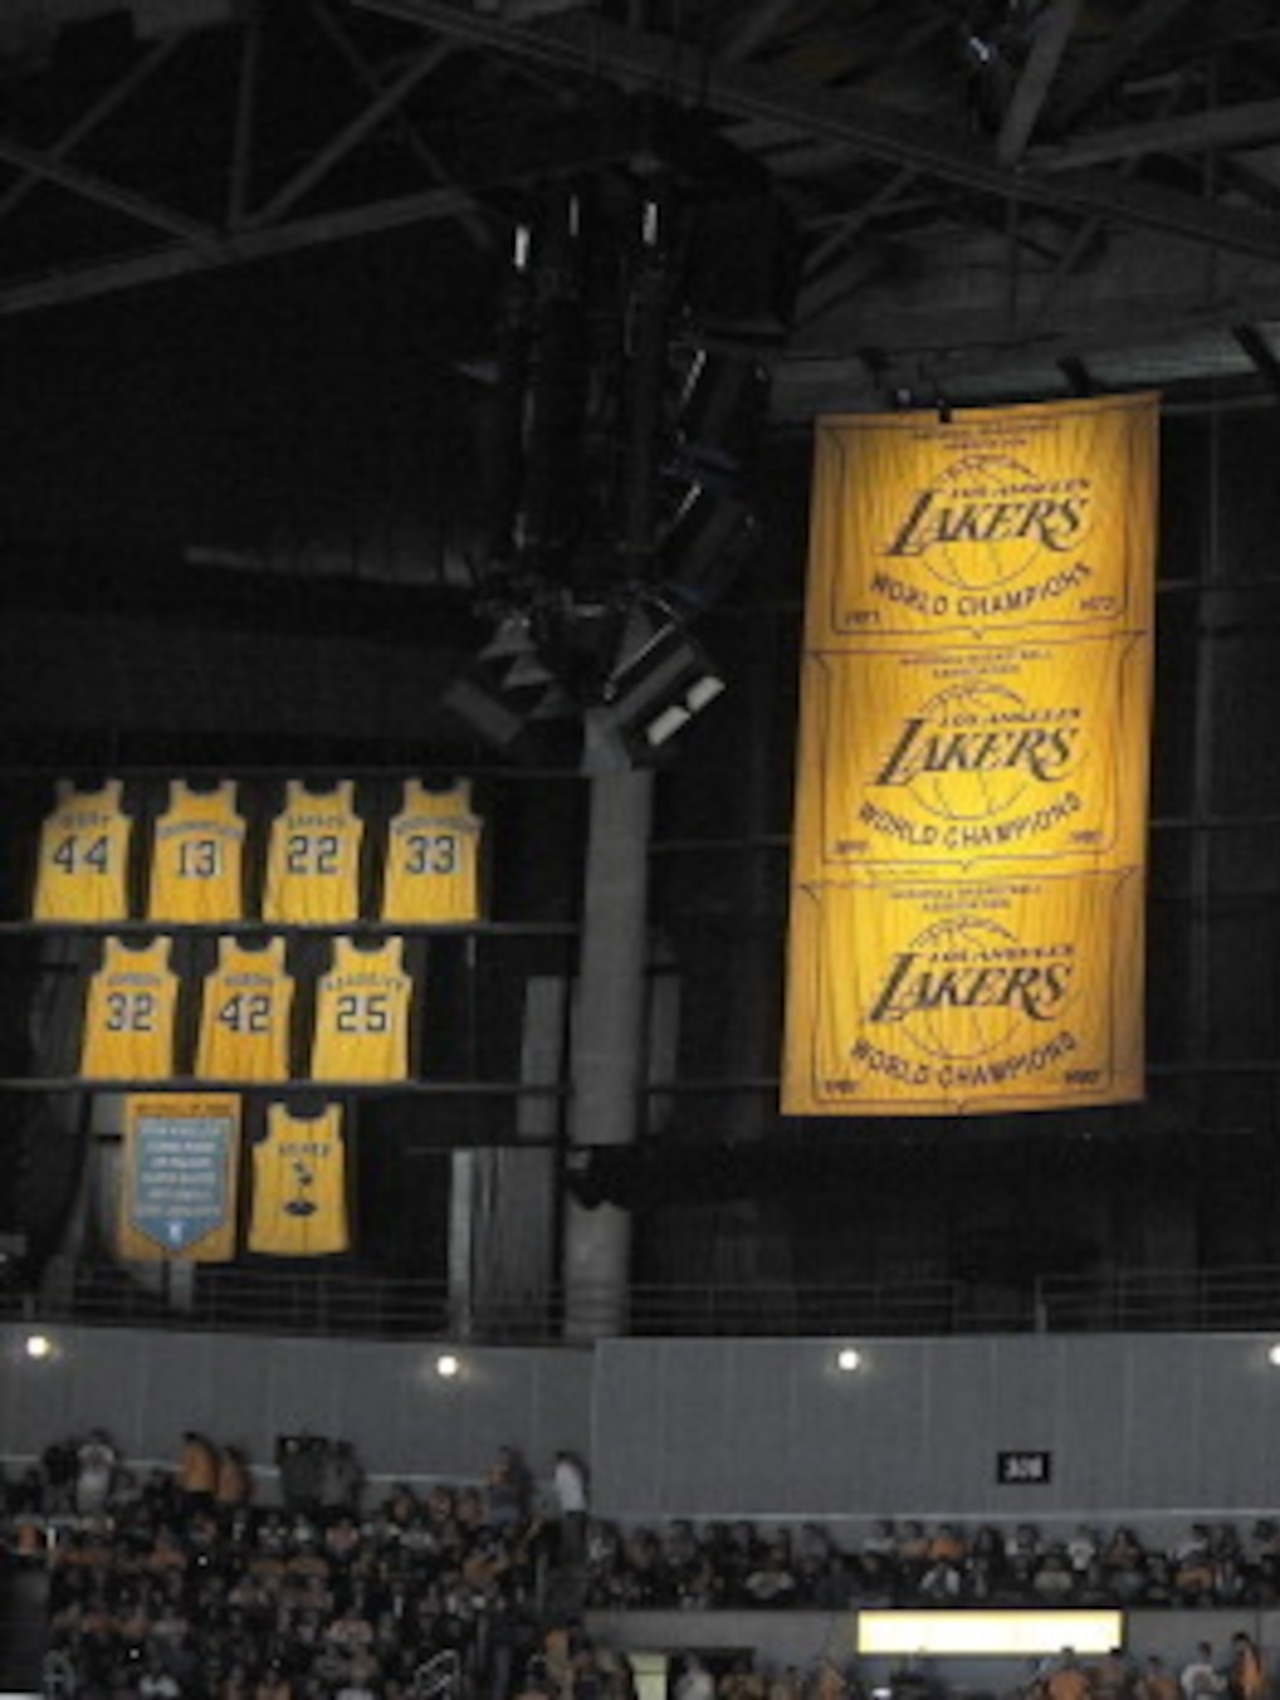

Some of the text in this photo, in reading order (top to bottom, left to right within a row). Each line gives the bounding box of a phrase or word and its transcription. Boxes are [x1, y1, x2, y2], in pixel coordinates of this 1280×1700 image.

[883, 489, 1090, 557] LAKERS
[870, 559, 1093, 617] WORLD CHAMPIONS
[873, 718, 1079, 788] LAKERS
[858, 790, 1083, 850] WORLD CHAMPIONS
[54, 835, 109, 874] 44
[178, 840, 216, 878] 13
[287, 835, 339, 874] 22
[405, 835, 455, 874] 33
[865, 953, 1073, 1023] LAKERS
[106, 991, 153, 1031] 32
[218, 995, 270, 1032] 42
[336, 995, 387, 1032] 25
[850, 1029, 1078, 1088] WORLD CHAMPIONS
